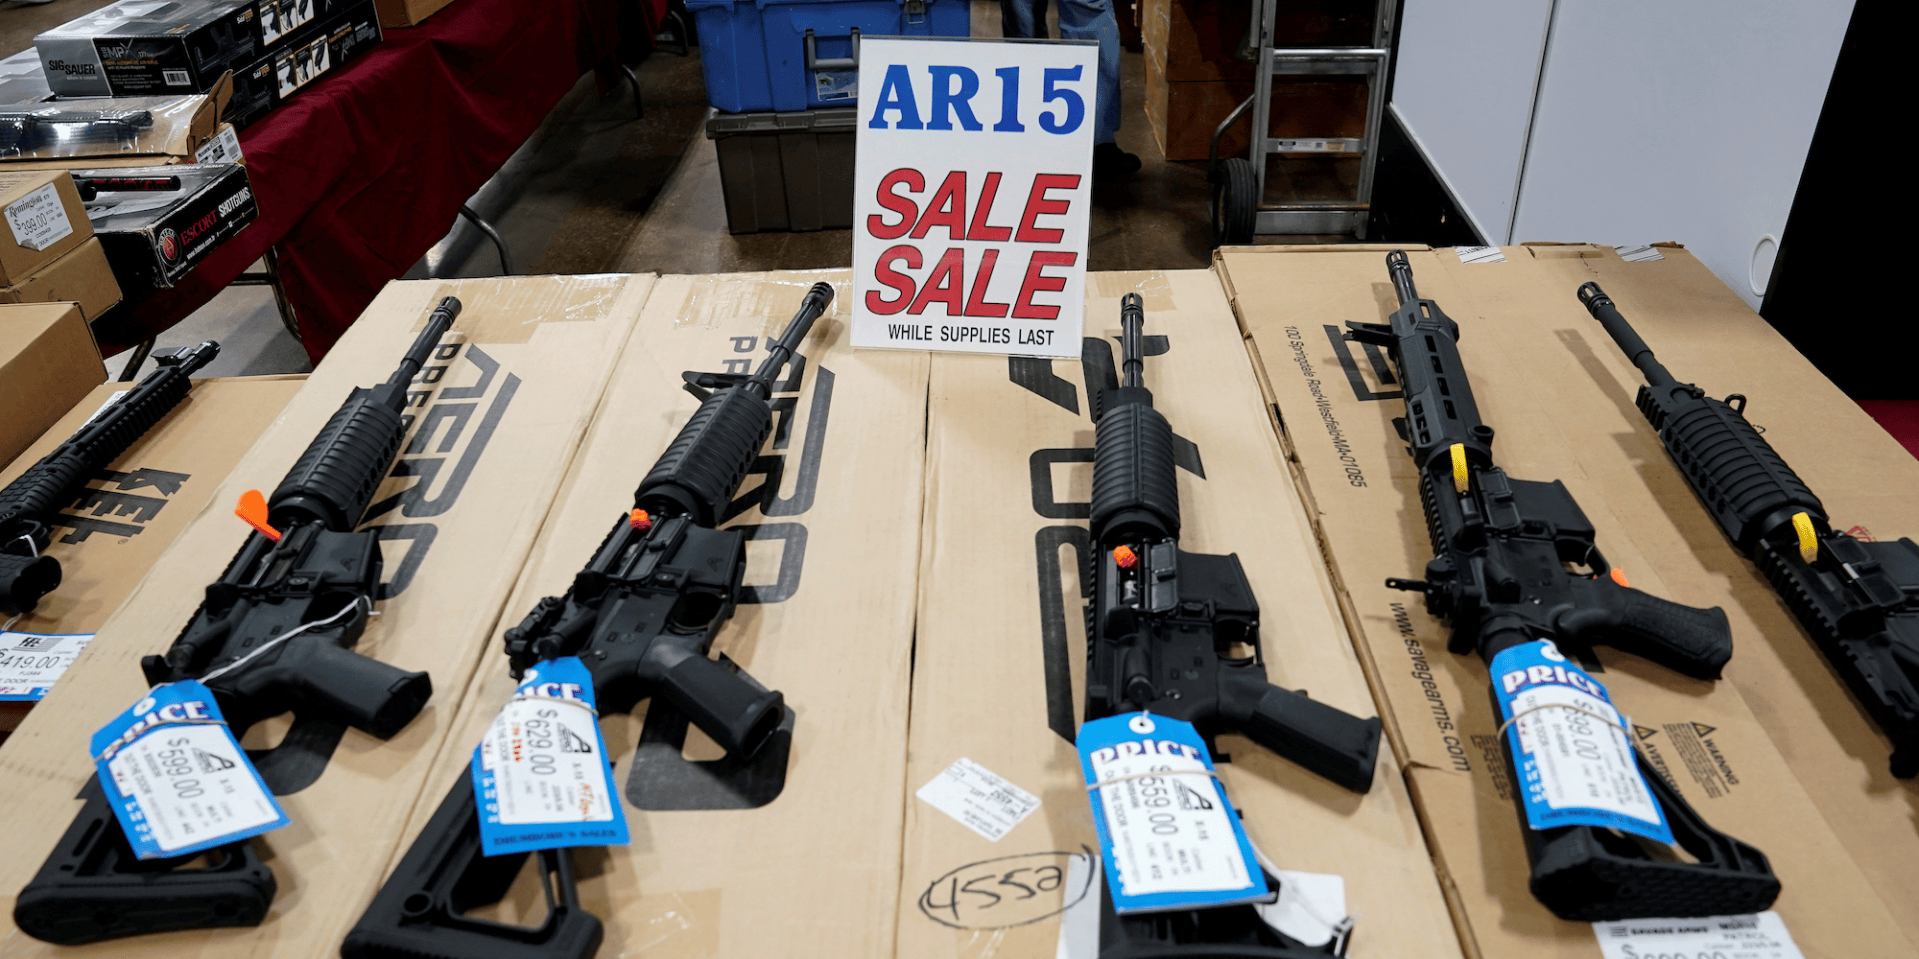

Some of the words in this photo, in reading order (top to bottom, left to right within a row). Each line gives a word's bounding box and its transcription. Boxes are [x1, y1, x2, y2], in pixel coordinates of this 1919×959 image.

[49, 60, 64, 70] SIG
[65, 64, 95, 75] SAUER
[868, 64, 1085, 135] AR15
[9, 194, 42, 218] Remington
[180, 210, 217, 246] ESCORT
[218, 187, 250, 218] SHOTGUNS
[866, 168, 1082, 243] SALE
[865, 244, 1078, 320] SALE
[888, 323, 933, 342] WHILE
[940, 325, 1011, 345] SUPPLIES
[1018, 329, 1054, 346] LAST
[1284, 325, 1301, 340] 100
[1288, 340, 1316, 378] Springdale
[1390, 602, 1471, 772] www.savagearms.com
[1703, 738, 1739, 786] WARNING
